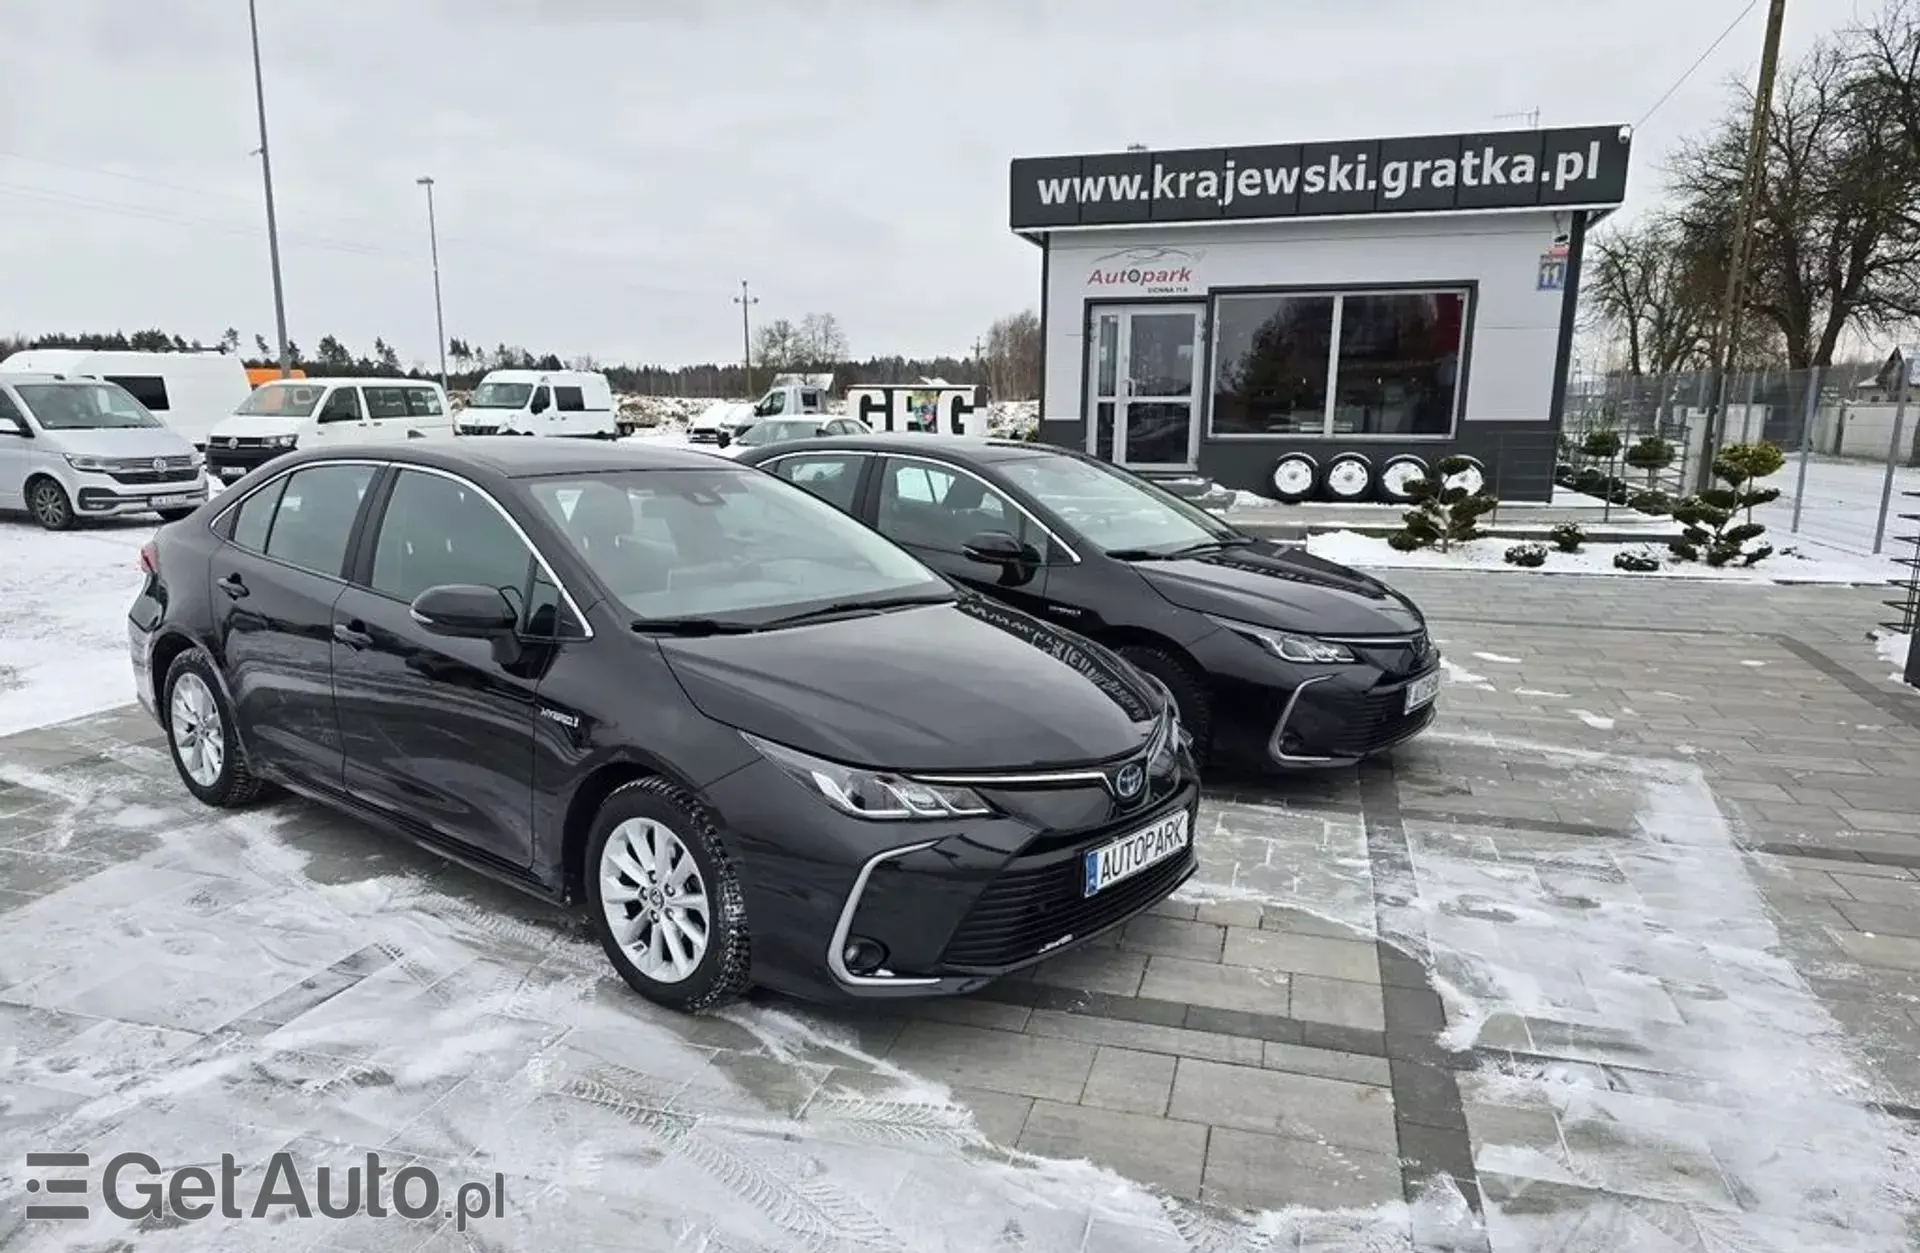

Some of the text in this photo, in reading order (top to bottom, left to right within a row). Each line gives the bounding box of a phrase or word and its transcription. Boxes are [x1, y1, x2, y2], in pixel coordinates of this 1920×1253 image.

[1037, 141, 1600, 206] www.krajewski.gratka.pl
[1087, 267, 1192, 286] Autopark
[1101, 815, 1184, 884] AUTOPARK
